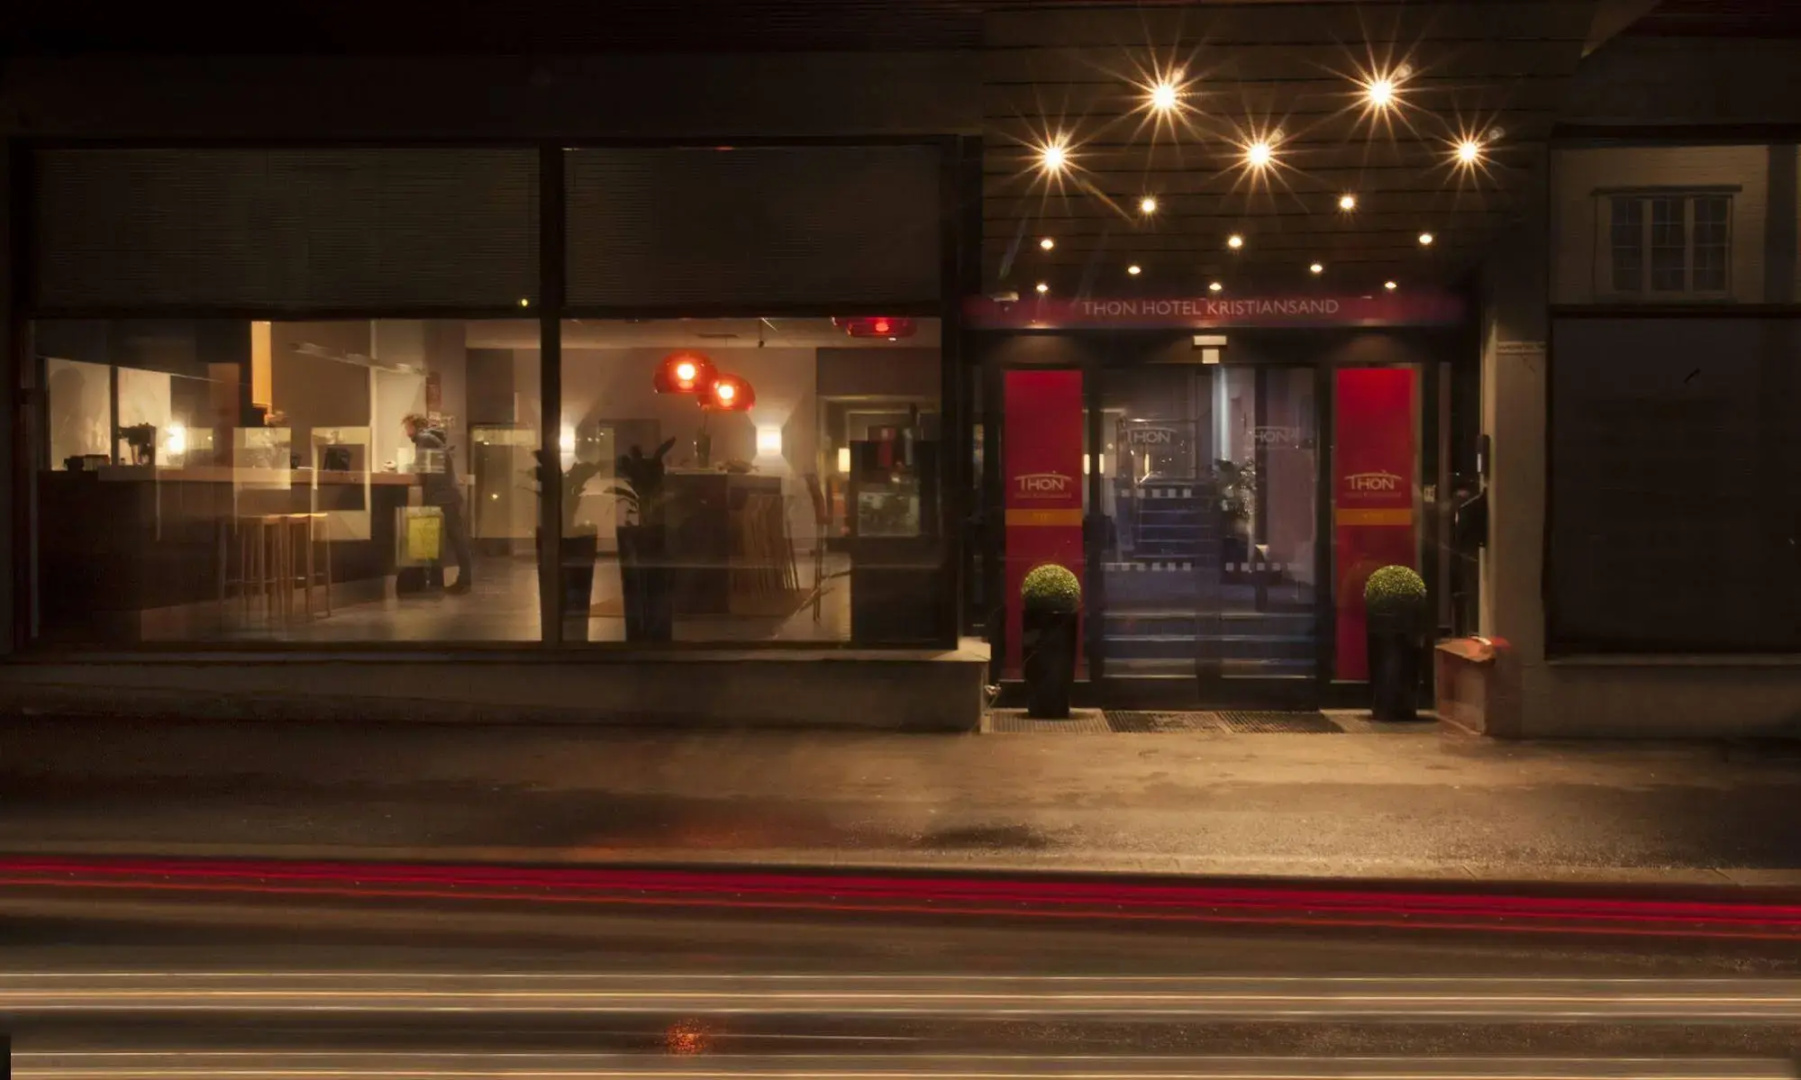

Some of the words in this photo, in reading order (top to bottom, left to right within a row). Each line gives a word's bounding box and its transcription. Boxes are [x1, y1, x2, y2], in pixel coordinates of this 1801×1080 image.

[1082, 301, 1137, 316] THON
[1142, 301, 1201, 316] HOTEL
[1206, 300, 1340, 316] KRISTIANSAND
[1120, 427, 1177, 443] THON
[1245, 426, 1298, 443] HON
[1014, 472, 1072, 491] THON
[1344, 472, 1402, 491] THON
